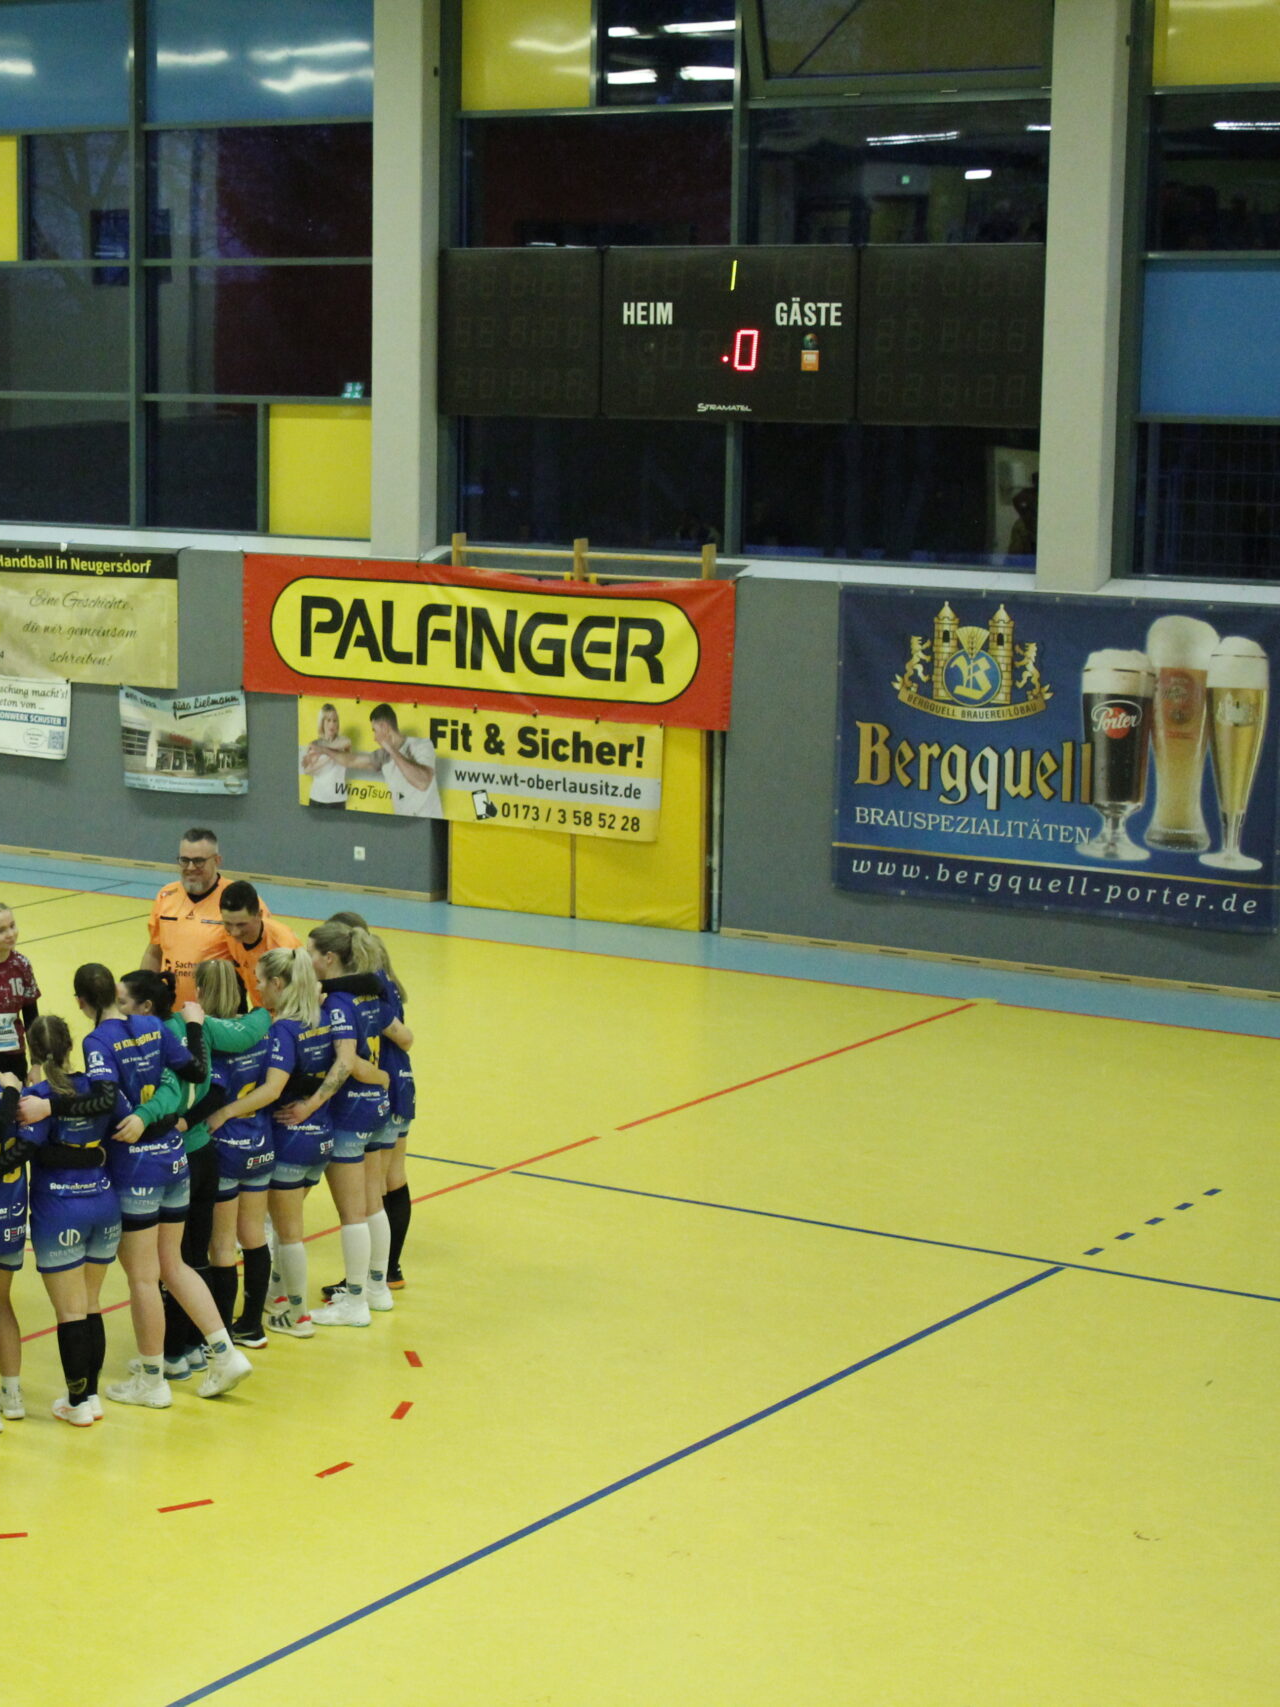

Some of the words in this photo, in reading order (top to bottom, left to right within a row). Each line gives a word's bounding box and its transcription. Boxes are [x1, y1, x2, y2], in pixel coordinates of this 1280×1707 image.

[623, 302, 673, 326] HEIM
[775, 298, 842, 327] GÄSTE
[56, 555, 68, 570] in
[71, 558, 151, 575] Neugersdorf
[22, 620, 39, 633] die
[67, 623, 138, 640] gemeinsam
[300, 594, 666, 685] PALFINGER
[49, 650, 113, 666] schreiben!
[20, 700, 36, 709] von
[907, 693, 956, 717] BERGQUELL
[1091, 699, 1143, 733] Porter
[30, 714, 62, 725] SCHUSTER
[429, 718, 472, 753] Fit
[483, 722, 506, 757] &
[517, 726, 646, 769] Sicher!
[854, 721, 1093, 811] Bergquell
[334, 782, 393, 801] WingTsun
[455, 769, 642, 800] www.wt-oberlausitz.de
[502, 802, 540, 822] 0173
[545, 806, 552, 823] /
[557, 808, 567, 825] 3
[573, 810, 593, 827] 58
[598, 812, 617, 830] 52
[621, 815, 640, 833] 28
[855, 806, 1091, 844] BRAUSPEZIALITÄTEN
[852, 857, 1258, 914] www.bergquell-porter.de
[175, 960, 197, 968] Sach
[175, 968, 195, 978] Ener
